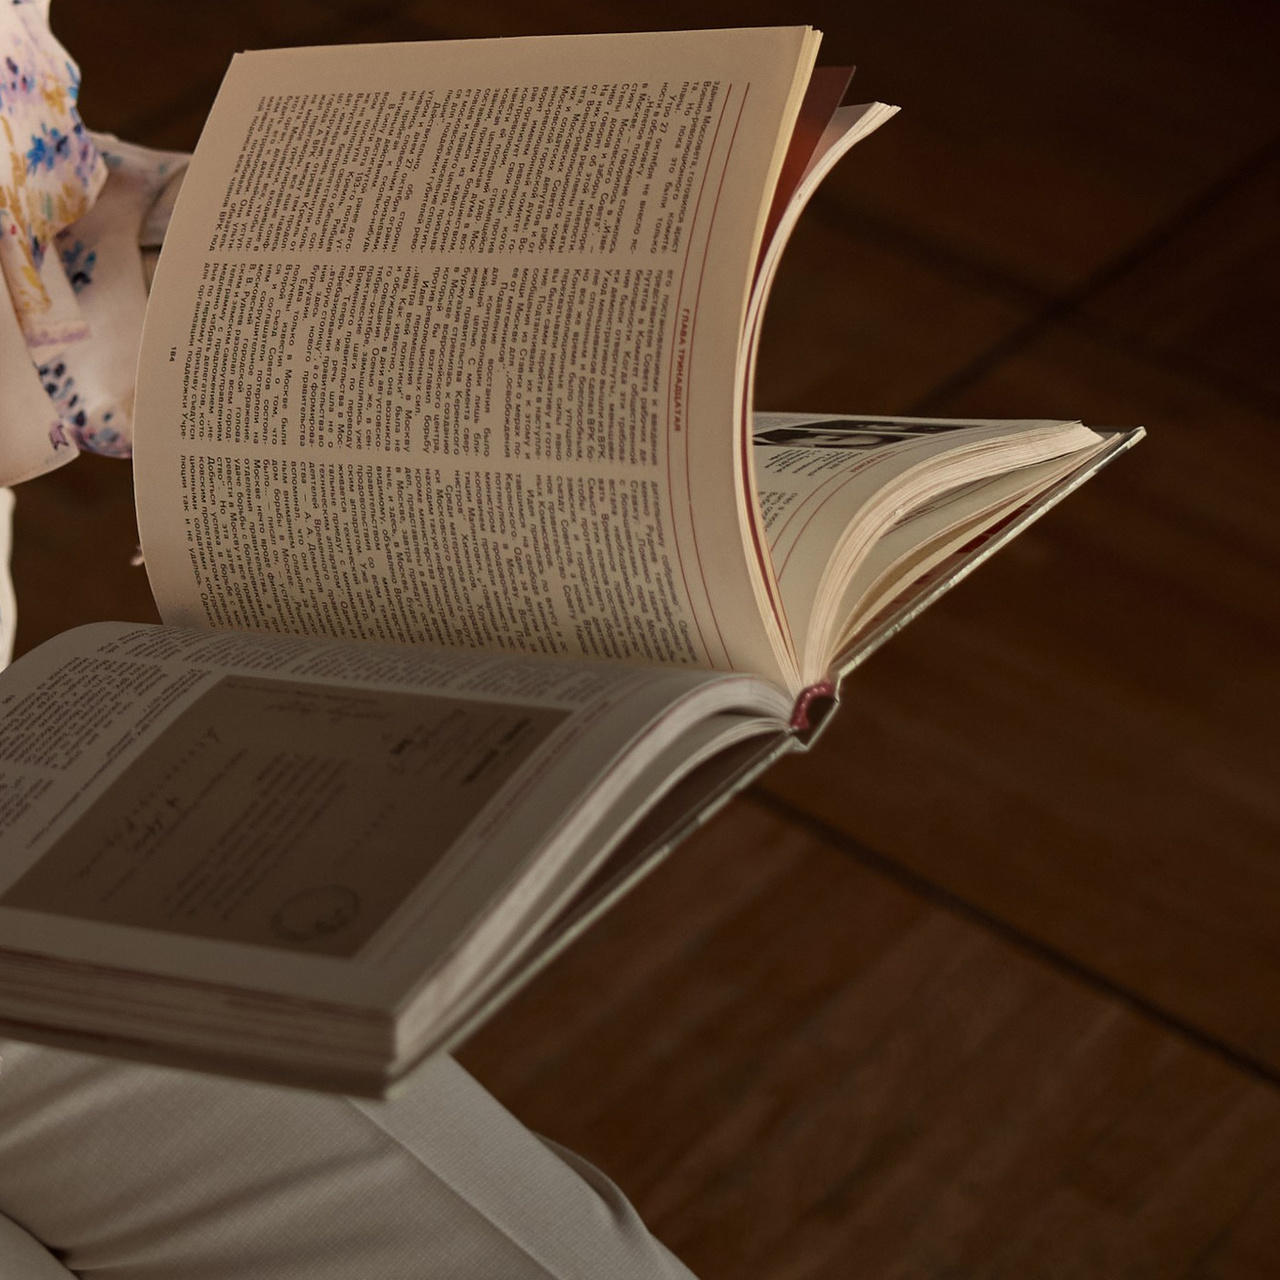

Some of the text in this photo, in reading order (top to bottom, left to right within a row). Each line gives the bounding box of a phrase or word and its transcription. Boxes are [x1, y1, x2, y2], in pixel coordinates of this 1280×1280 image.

[367, 91, 391, 143] воренности
[369, 91, 382, 110] ром
[407, 89, 427, 130] чивались
[420, 89, 436, 118] утром
[492, 87, 510, 126] ковская
[503, 86, 520, 123] нанести
[662, 94, 678, 119] Утро
[351, 118, 372, 163] покинула
[377, 112, 391, 134] силу
[408, 131, 421, 155] днем
[359, 145, 371, 167] рота
[359, 136, 383, 195] достигнутой
[387, 134, 411, 192] словесными
[469, 126, 489, 173] принятом
[474, 130, 497, 189] центральная
[482, 143, 502, 194] последний
[646, 137, 663, 180] октября
[348, 171, 365, 202] 193-го
[391, 172, 408, 213] октября
[403, 183, 414, 201] обе
[466, 192, 478, 218] дума
[339, 204, 353, 235] полка
[351, 196, 364, 224] ранее
[390, 210, 406, 253] стороны
[325, 218, 342, 253] Рябцев
[201, 262, 211, 280] для
[209, 262, 220, 282] рые
[212, 262, 229, 311] медленно
[235, 262, 247, 289] ским
[263, 263, 274, 283] нем
[278, 263, 294, 300] Второй
[285, 263, 301, 313] получены
[295, 278, 309, 303] Едва
[490, 266, 500, 287] для
[188, 284, 206, 347] организации
[236, 290, 251, 326] Руднев
[453, 266, 472, 323] буржуазия
[196, 300, 211, 344] первому
[205, 313, 217, 353] избрать
[224, 300, 238, 345] земским
[247, 290, 267, 377] сокрушительное
[258, 296, 275, 362] соглашатели
[270, 308, 282, 338] съезд
[288, 310, 300, 347] только
[475, 294, 494, 387] контрреволюции
[169, 346, 177, 362] 184
[229, 328, 242, 376] разослал
[234, 263, 265, 444] московский городской голова
[276, 321, 289, 368] известия
[445, 326, 459, 388] стремилась
[452, 266, 479, 456] жения правительства Керенского
[181, 350, 194, 409] поддержки
[190, 346, 203, 392] призыву
[264, 346, 277, 391] Советов
[281, 368, 293, 410] Москве
[483, 281, 509, 458] Подавление восстания было
[674, 308, 690, 432] ГЛАВА ТРИНАДЦАТАЯ
[216, 347, 230, 442] самоуправлениям
[226, 378, 235, 405] всем
[253, 369, 264, 424] потерпели
[473, 394, 481, 425] лишь
[188, 393, 198, 441] съедутся
[280, 416, 289, 446] были
[442, 401, 451, 455] созданию
[180, 454, 188, 489] люции
[328, 463, 337, 507] тальные
[182, 494, 190, 512] так
[515, 473, 527, 529] тавшимся
[243, 457, 254, 513] отделения
[270, 616, 282, 634] при
[253, 458, 291, 634] Москве нечто вроде филиального
[331, 512, 344, 554] приедут
[413, 468, 423, 504] кроме
[418, 507, 436, 580] министерства
[365, 464, 407, 644] правительством министерство
[405, 492, 423, 567] представлены
[419, 579, 436, 615] данное
[435, 488, 452, 562] Московского
[446, 565, 465, 613] военного
[459, 614, 477, 649] округа
[381, 528, 398, 585] объявлено
[393, 587, 417, 644] Временным
[199, 592, 217, 628] Однако
